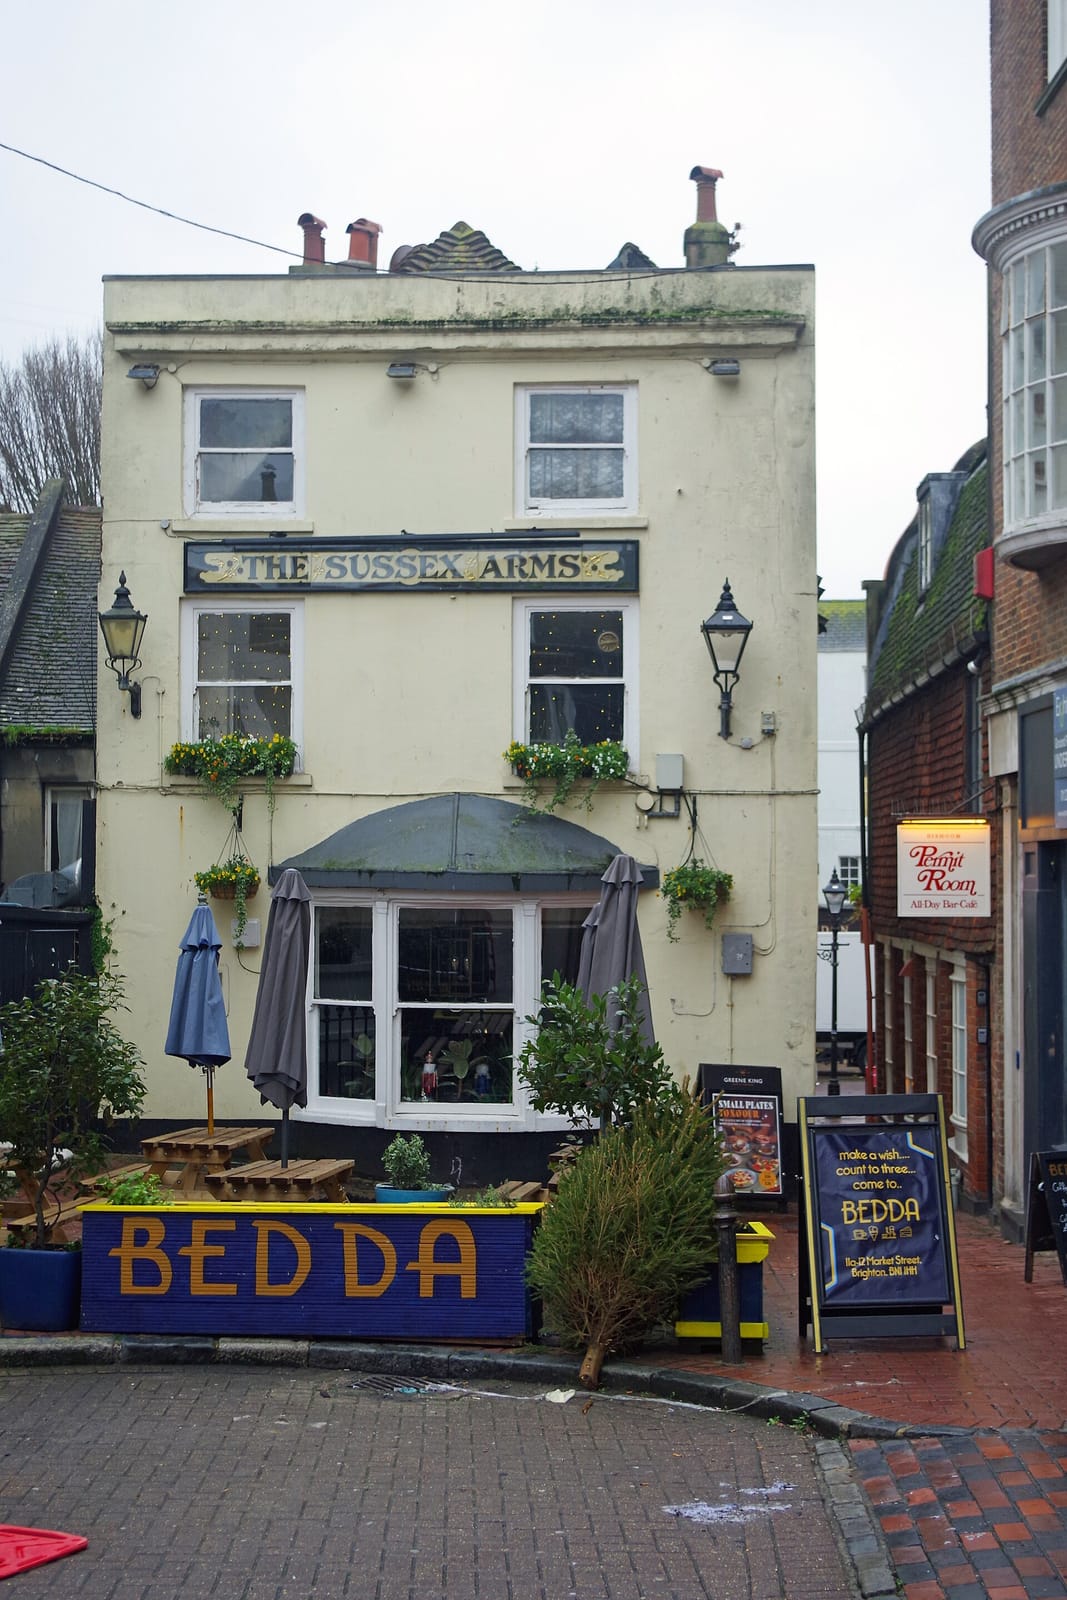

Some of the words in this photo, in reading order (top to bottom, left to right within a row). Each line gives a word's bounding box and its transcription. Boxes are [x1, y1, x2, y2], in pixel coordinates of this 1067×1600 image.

[241, 554, 309, 580] THE
[325, 553, 465, 580] SUSSEX
[480, 554, 581, 579] ARMS
[909, 845, 964, 872] Permit
[917, 869, 977, 896] Room
[911, 899, 940, 910] All-Day
[718, 1100, 744, 1109] SMALL
[745, 1101, 774, 1110] PLATES
[839, 1148, 868, 1160] make
[869, 1152, 877, 1160] a
[836, 1164, 867, 1176] count
[867, 1164, 880, 1174] to
[852, 1181, 884, 1190] come
[841, 1198, 920, 1225] BEDDA
[108, 1216, 477, 1299] BEDDA
[866, 1255, 894, 1265] Market
